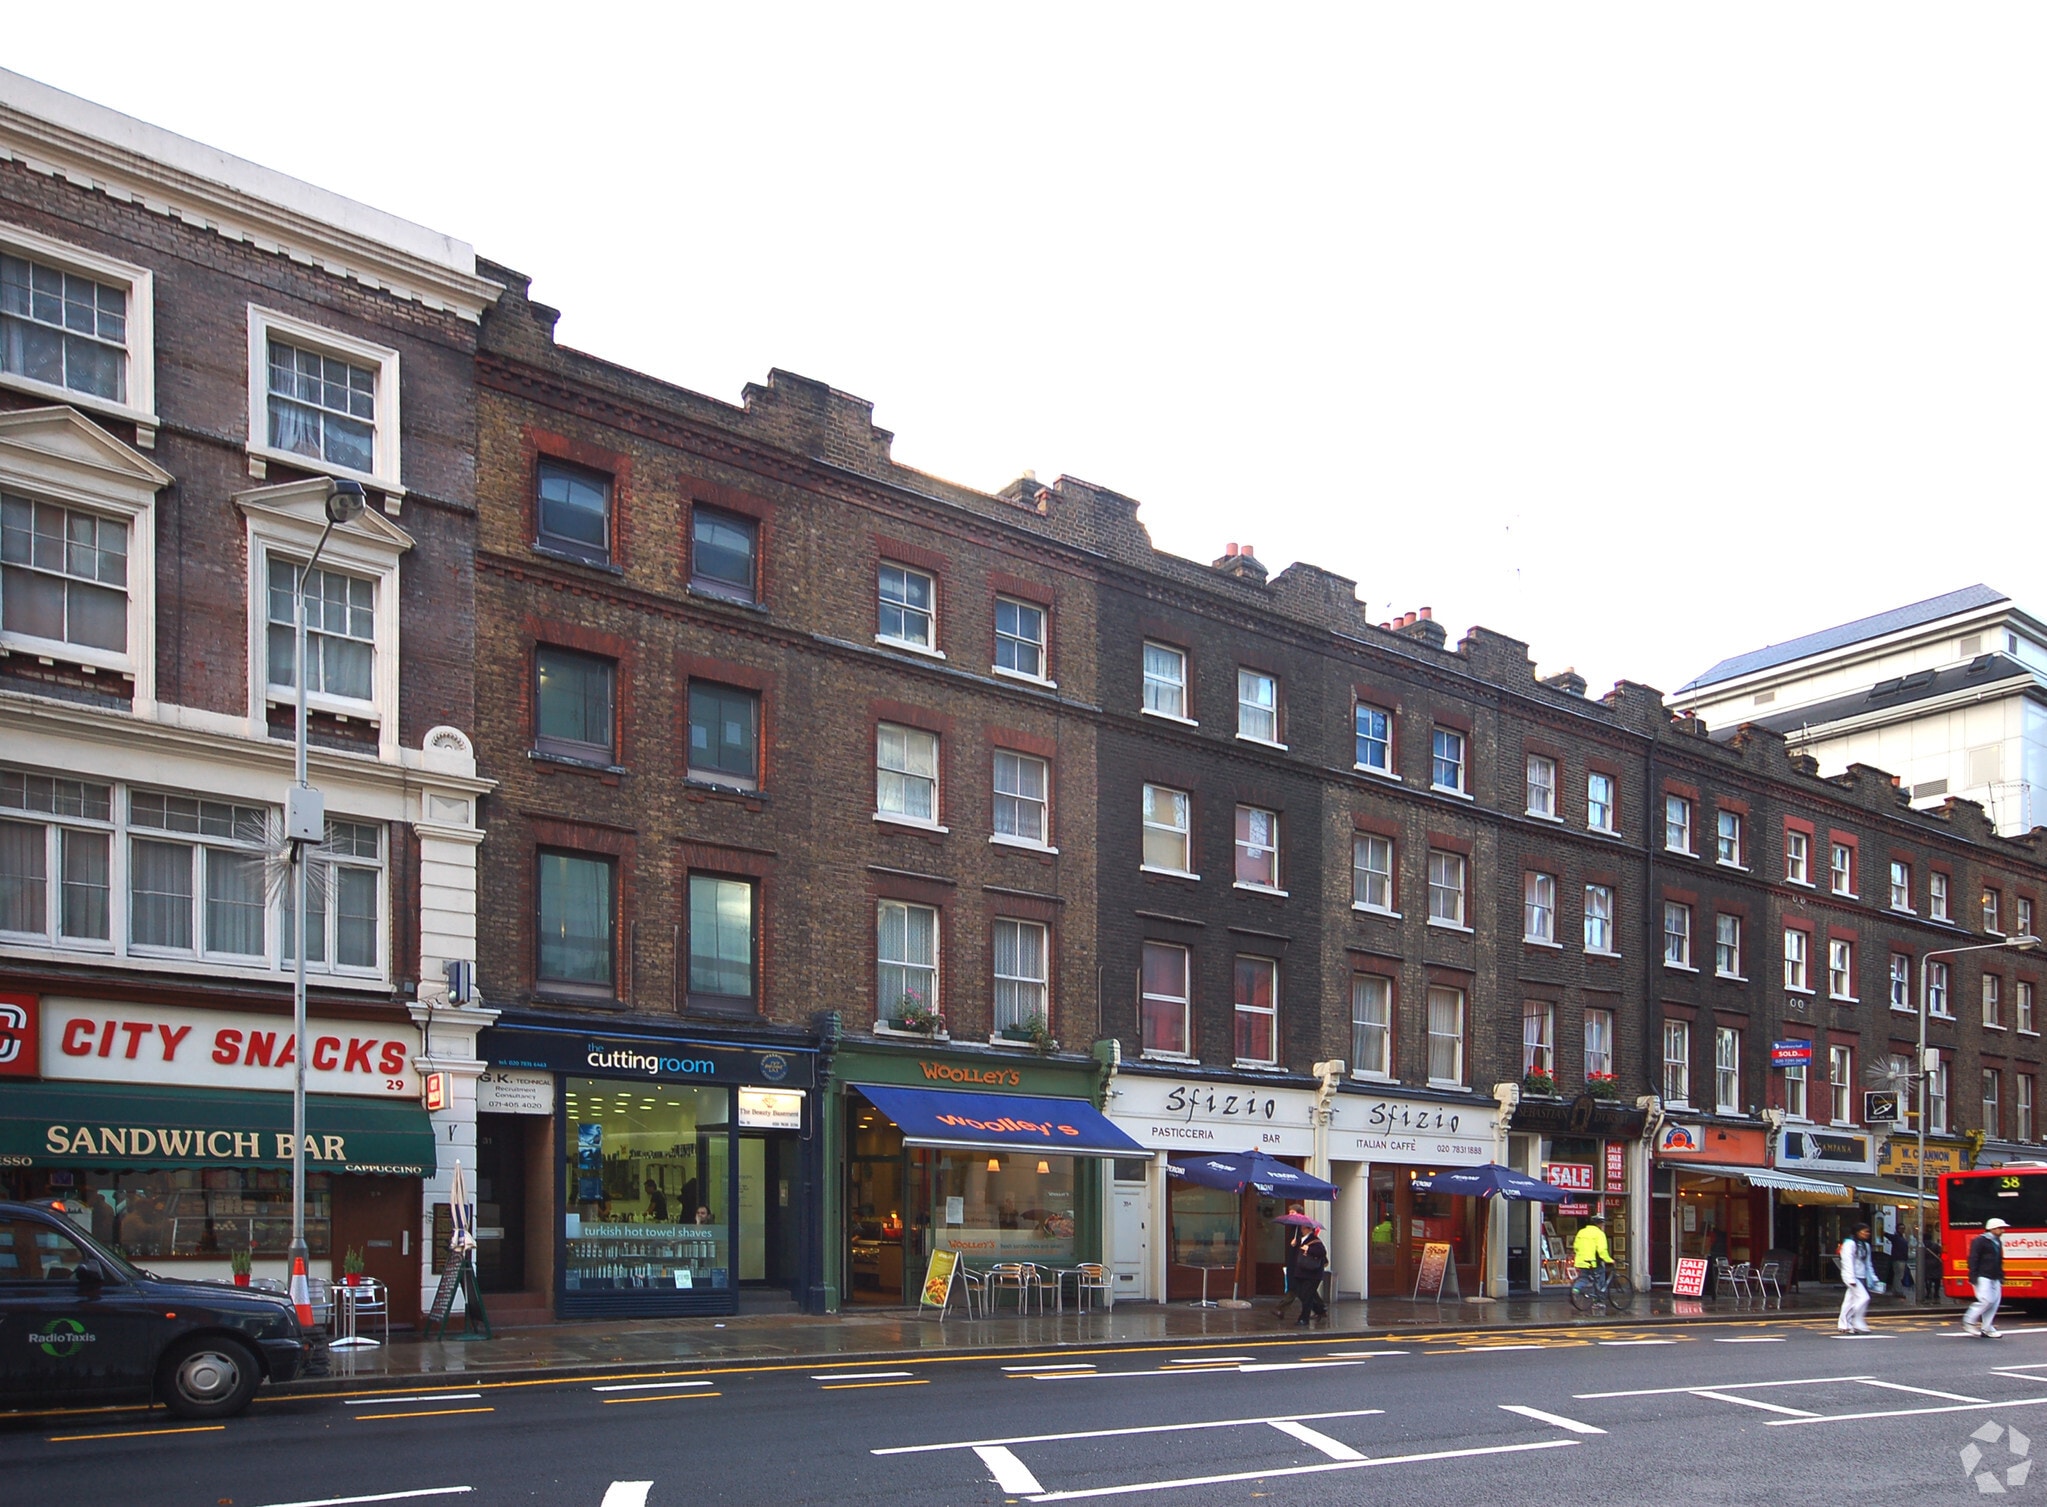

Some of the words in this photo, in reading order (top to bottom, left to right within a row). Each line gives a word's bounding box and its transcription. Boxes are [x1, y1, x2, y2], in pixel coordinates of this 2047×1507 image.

[61, 1018, 192, 1062] CITY
[212, 1029, 407, 1076] SNACKS
[587, 1042, 605, 1052] the
[1778, 1050, 1798, 1058] SOLD
[587, 1050, 715, 1075] cuttingroom
[386, 1079, 404, 1091] 29
[516, 1078, 551, 1086] TECHNICAL
[1166, 1086, 1275, 1124] Sfizio
[752, 1109, 771, 1117] Beauty
[1369, 1102, 1459, 1137] Sfizio
[1151, 1126, 1214, 1140] PASTICCERIA
[1262, 1133, 1281, 1144] BAR
[46, 1125, 260, 1158] SANDWICH
[276, 1133, 347, 1161] BAR
[1356, 1139, 1387, 1149] ITALIAN
[1390, 1138, 1416, 1151] CAFFÈ
[1437, 1144, 1450, 1153] 020
[1607, 1146, 1622, 1154] SALE
[1607, 1154, 1622, 1162] SALE
[1912, 1149, 1950, 1162] CANNON
[345, 1164, 422, 1174] CAPPUCCINO
[1607, 1162, 1622, 1170] SALE
[1550, 1166, 1590, 1187] SALE
[1607, 1170, 1622, 1178] SALE
[1607, 1183, 1622, 1191] SALE
[2001, 1176, 2021, 1189] 38
[584, 1226, 622, 1237] turkish
[624, 1226, 643, 1237] hot
[645, 1227, 676, 1238] towel
[678, 1227, 712, 1238] shaves
[1681, 1260, 1704, 1269] SALE
[1680, 1268, 1702, 1277] SALE
[1678, 1276, 1700, 1286] SALE
[1677, 1284, 1699, 1294] SALE
